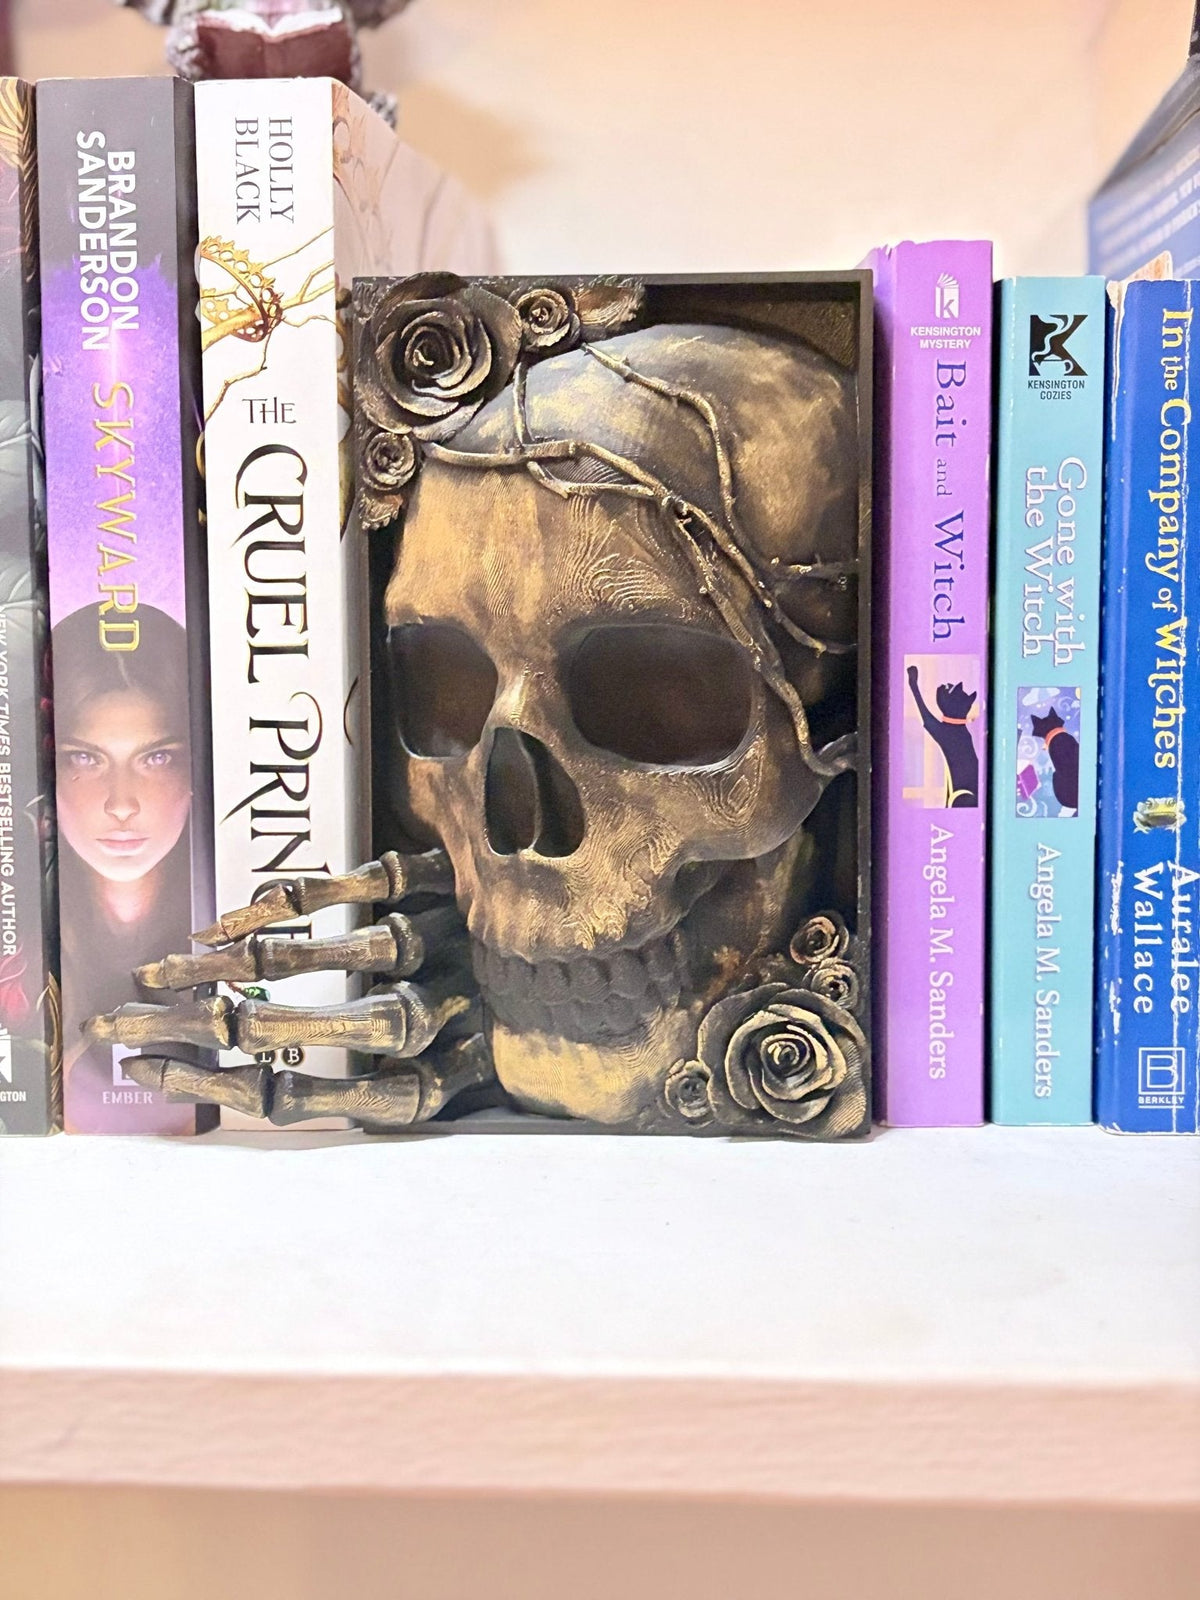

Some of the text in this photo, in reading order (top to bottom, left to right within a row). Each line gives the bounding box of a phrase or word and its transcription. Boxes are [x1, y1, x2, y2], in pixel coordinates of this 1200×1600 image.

[235, 117, 260, 224] BLACK
[269, 117, 294, 223] HOLLY
[76, 130, 110, 351] SANDERSON
[107, 150, 139, 330] BRANDON
[910, 326, 981, 337] KENSINGTON
[919, 339, 971, 349] MYSTERY
[1160, 356, 1183, 390] the
[1162, 308, 1194, 348] In
[242, 397, 297, 424] THE
[1027, 380, 1085, 390] KENSINGTON
[1040, 391, 1072, 400] COZIES
[92, 382, 139, 652] SKYWARD
[933, 359, 967, 643] Bait and Witch
[1144, 398, 1192, 582] Company
[1022, 465, 1057, 658] the Witch
[1054, 456, 1087, 667] Gone with
[1152, 587, 1177, 613] of
[0, 703, 11, 756] TIMES
[218, 444, 331, 939] CRUEL PRIN
[1148, 616, 1187, 769] Witches
[0, 762, 15, 877] BESTSELLING
[1, 881, 17, 956] AUTHOR
[923, 823, 955, 1080] Angela M. Sanders
[1029, 843, 1062, 1098] Angela M. Sanders
[1133, 862, 1164, 1014] Wallace
[1167, 860, 1200, 1014] Auralee
[102, 1091, 153, 1104] EMBER
[1137, 1096, 1185, 1104] BERKLEY
